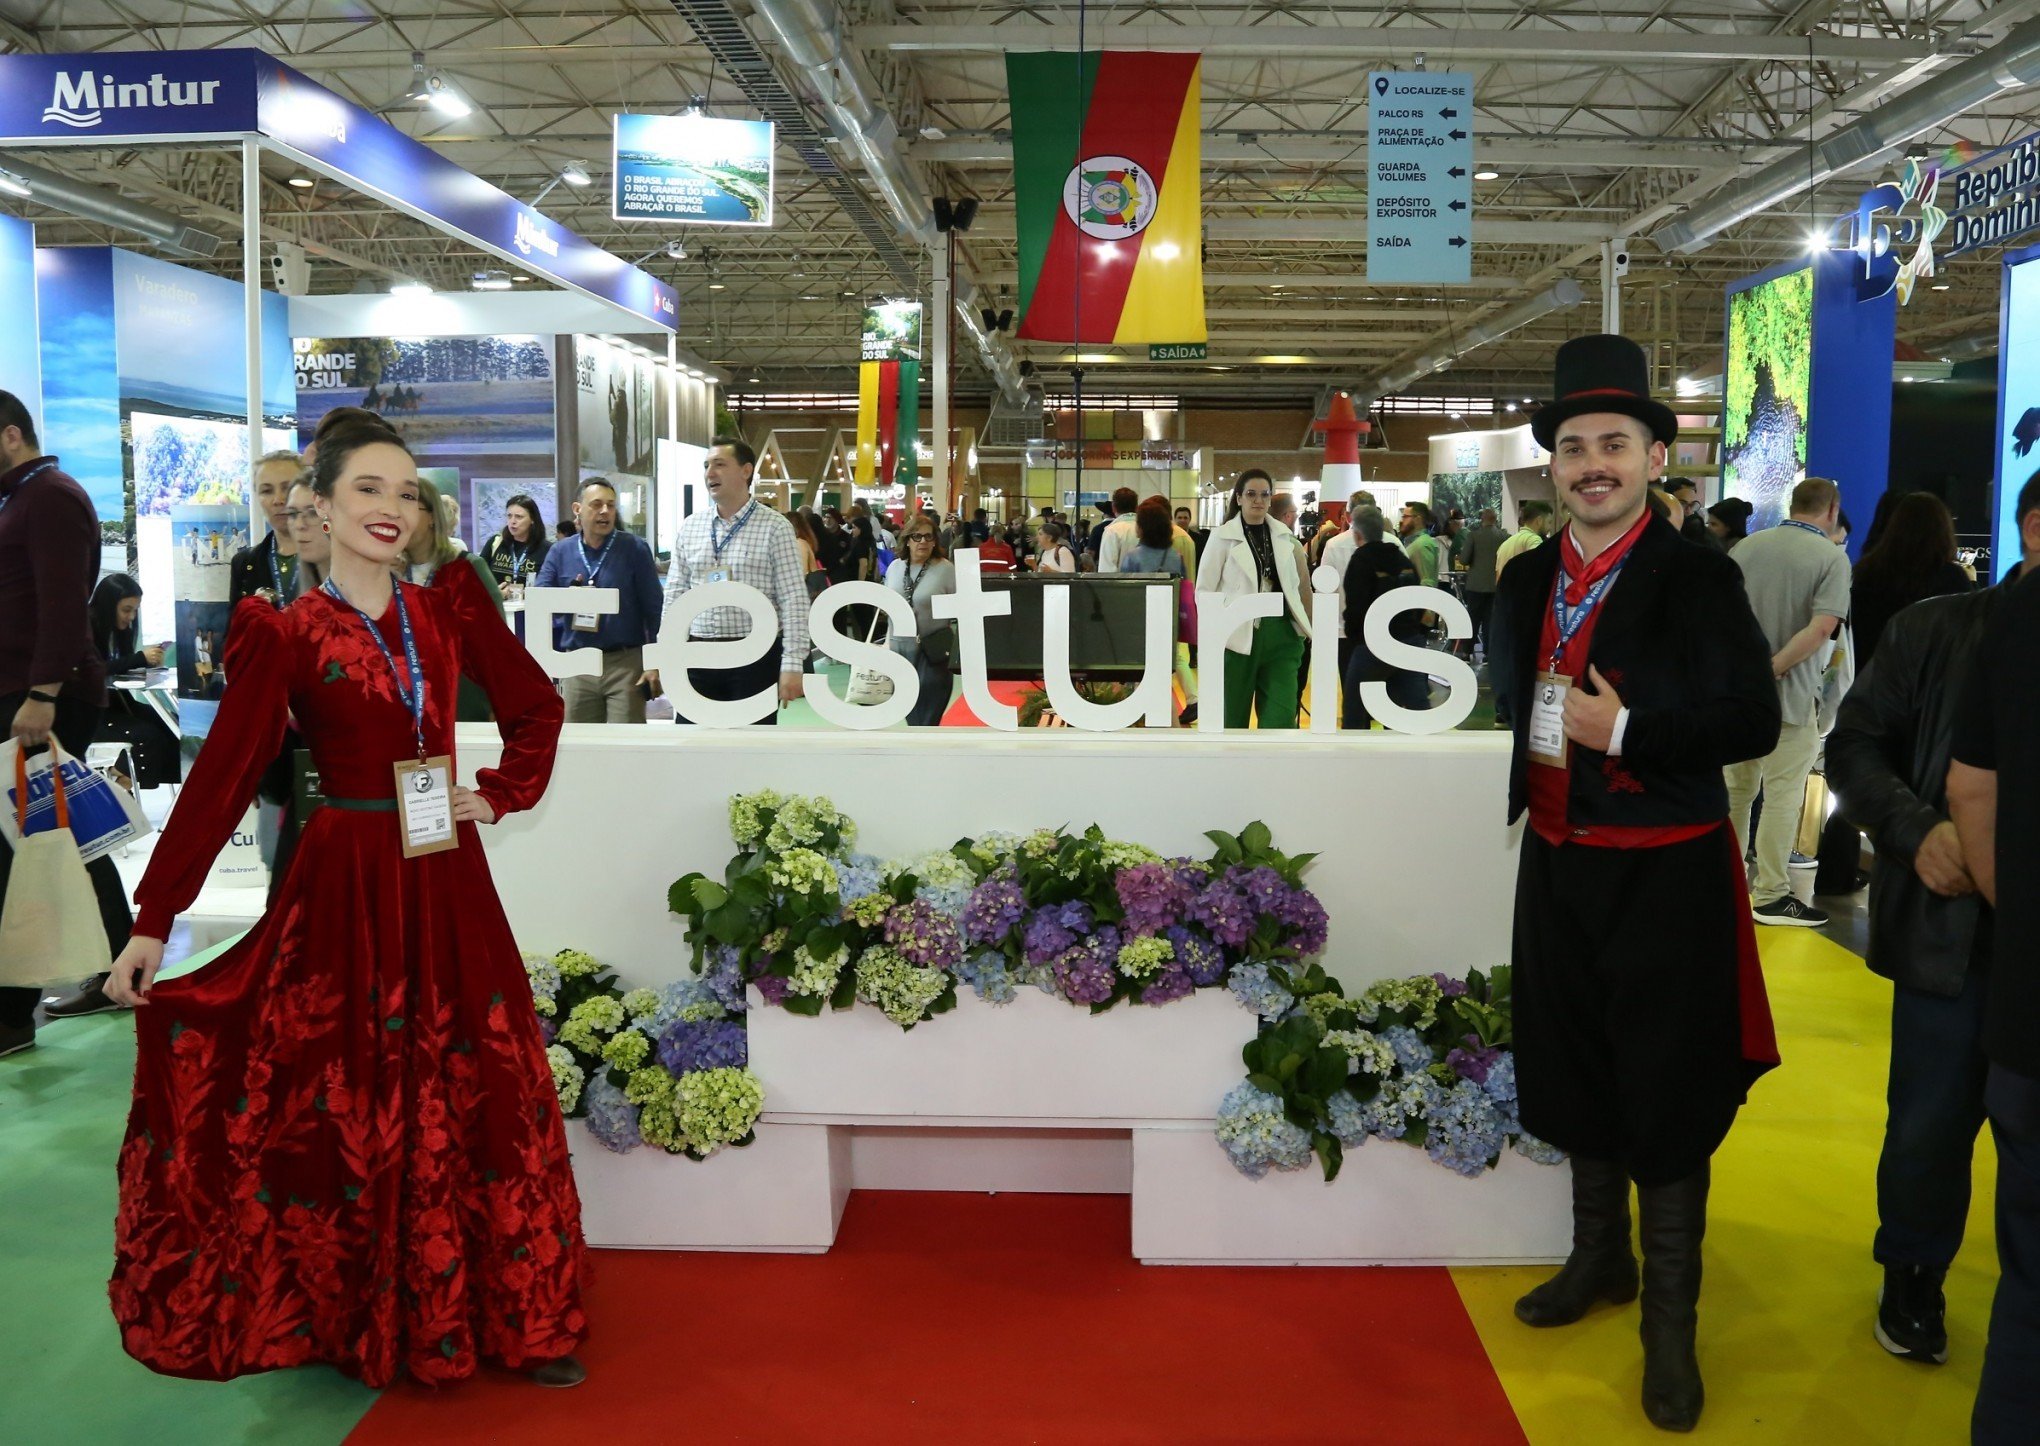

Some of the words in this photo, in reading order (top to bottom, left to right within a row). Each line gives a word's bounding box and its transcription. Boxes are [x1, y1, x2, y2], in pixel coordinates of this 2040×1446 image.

[52, 71, 220, 109] Mintur
[1395, 87, 1465, 95] LOCALIZE-SE
[1379, 110, 1409, 118] PALCO
[1412, 110, 1424, 118] RS
[1378, 129, 1410, 138] PRAÇA
[1378, 136, 1444, 147] ALIMENTAÇÃO
[1378, 163, 1420, 171] GUARDA
[624, 175, 631, 183] O
[633, 176, 663, 185] BRASIL
[1377, 173, 1426, 181] VOLUMES
[624, 184, 631, 192] O
[633, 185, 648, 193] RIO
[650, 185, 686, 195] GRANDE
[687, 187, 700, 196] DO
[624, 193, 654, 202] AGORA
[656, 195, 704, 205] QUEREMOS
[1377, 196, 1430, 207] DEPÓSITO
[624, 202, 664, 213] ABRAÇAR
[666, 203, 673, 212] O
[1377, 209, 1437, 217] EXPOSITOR
[1376, 235, 1411, 247] SAÍDA
[862, 341, 893, 350] GRANDE
[862, 350, 874, 360] DO
[1158, 345, 1199, 359] SAÍDA
[294, 353, 356, 370] RANDE
[295, 372, 308, 388] O
[311, 372, 347, 387] SUL
[525, 548, 1478, 735] Festuris
[231, 830, 259, 846] Cu
[219, 866, 258, 874] cuba.travel
